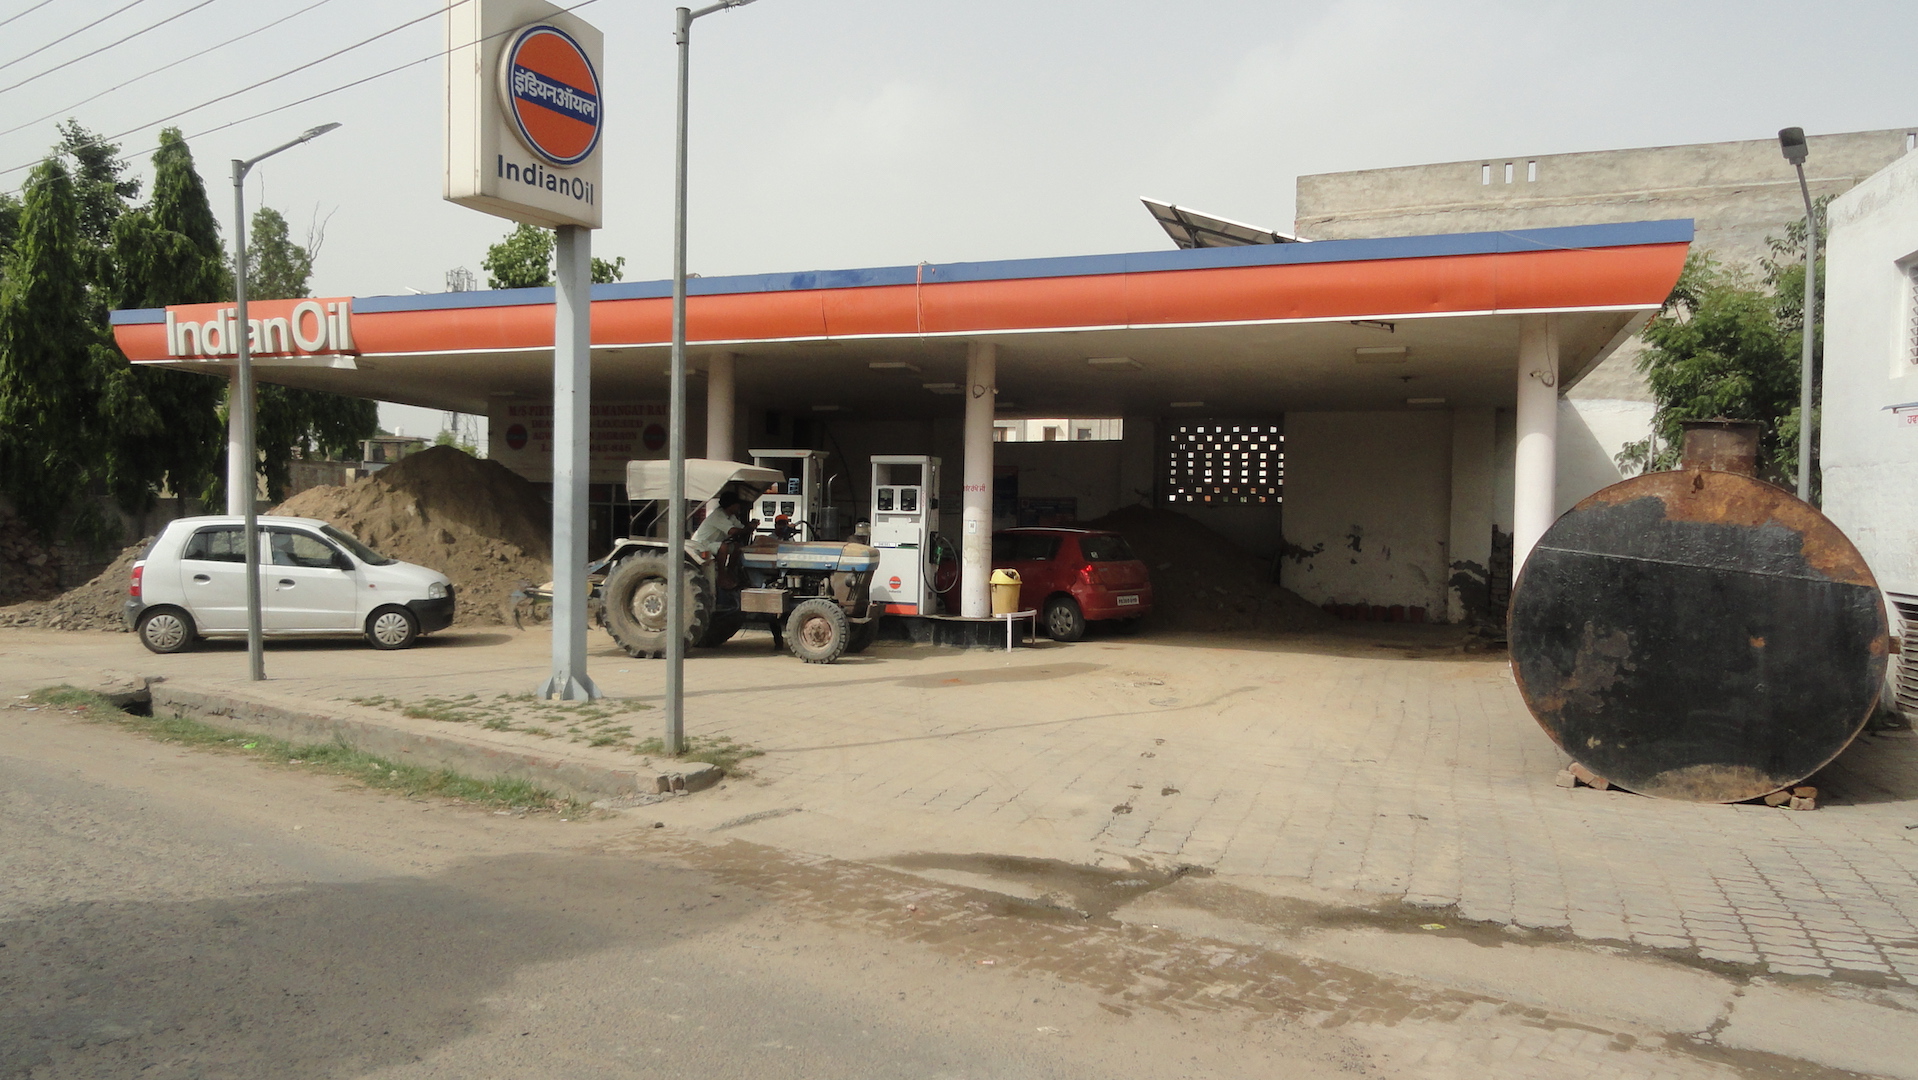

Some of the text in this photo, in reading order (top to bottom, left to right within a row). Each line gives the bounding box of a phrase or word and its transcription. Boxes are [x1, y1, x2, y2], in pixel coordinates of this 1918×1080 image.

[514, 68, 596, 119] इंडियनऑयल
[497, 154, 594, 205] IndianOil
[166, 301, 353, 356] IndianOil
